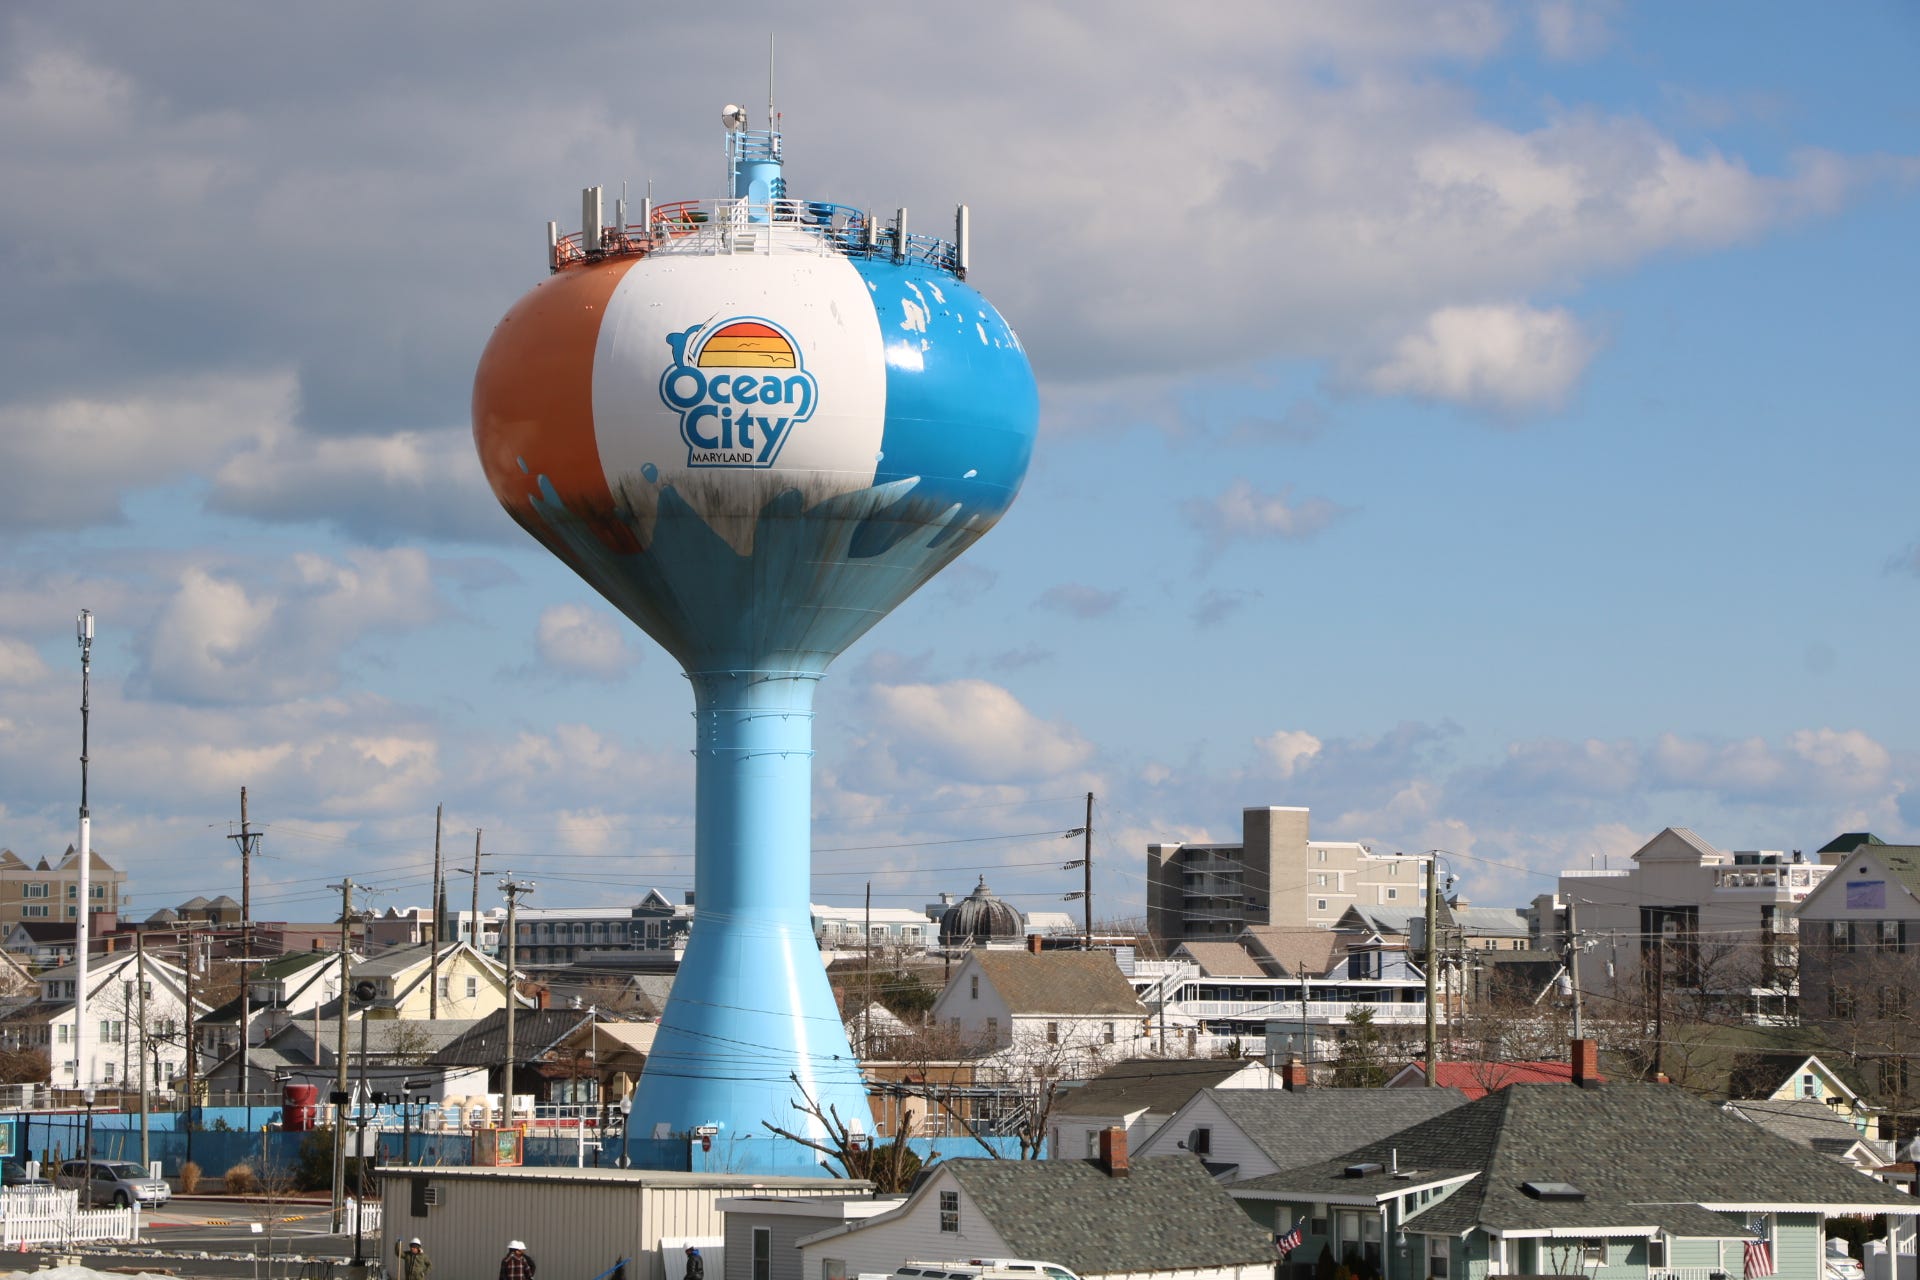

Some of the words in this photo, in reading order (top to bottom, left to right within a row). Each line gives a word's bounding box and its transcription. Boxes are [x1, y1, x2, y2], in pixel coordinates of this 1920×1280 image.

[665, 366, 811, 416] Ocean
[686, 405, 789, 462] City
[692, 453, 752, 462] MARYLAND
